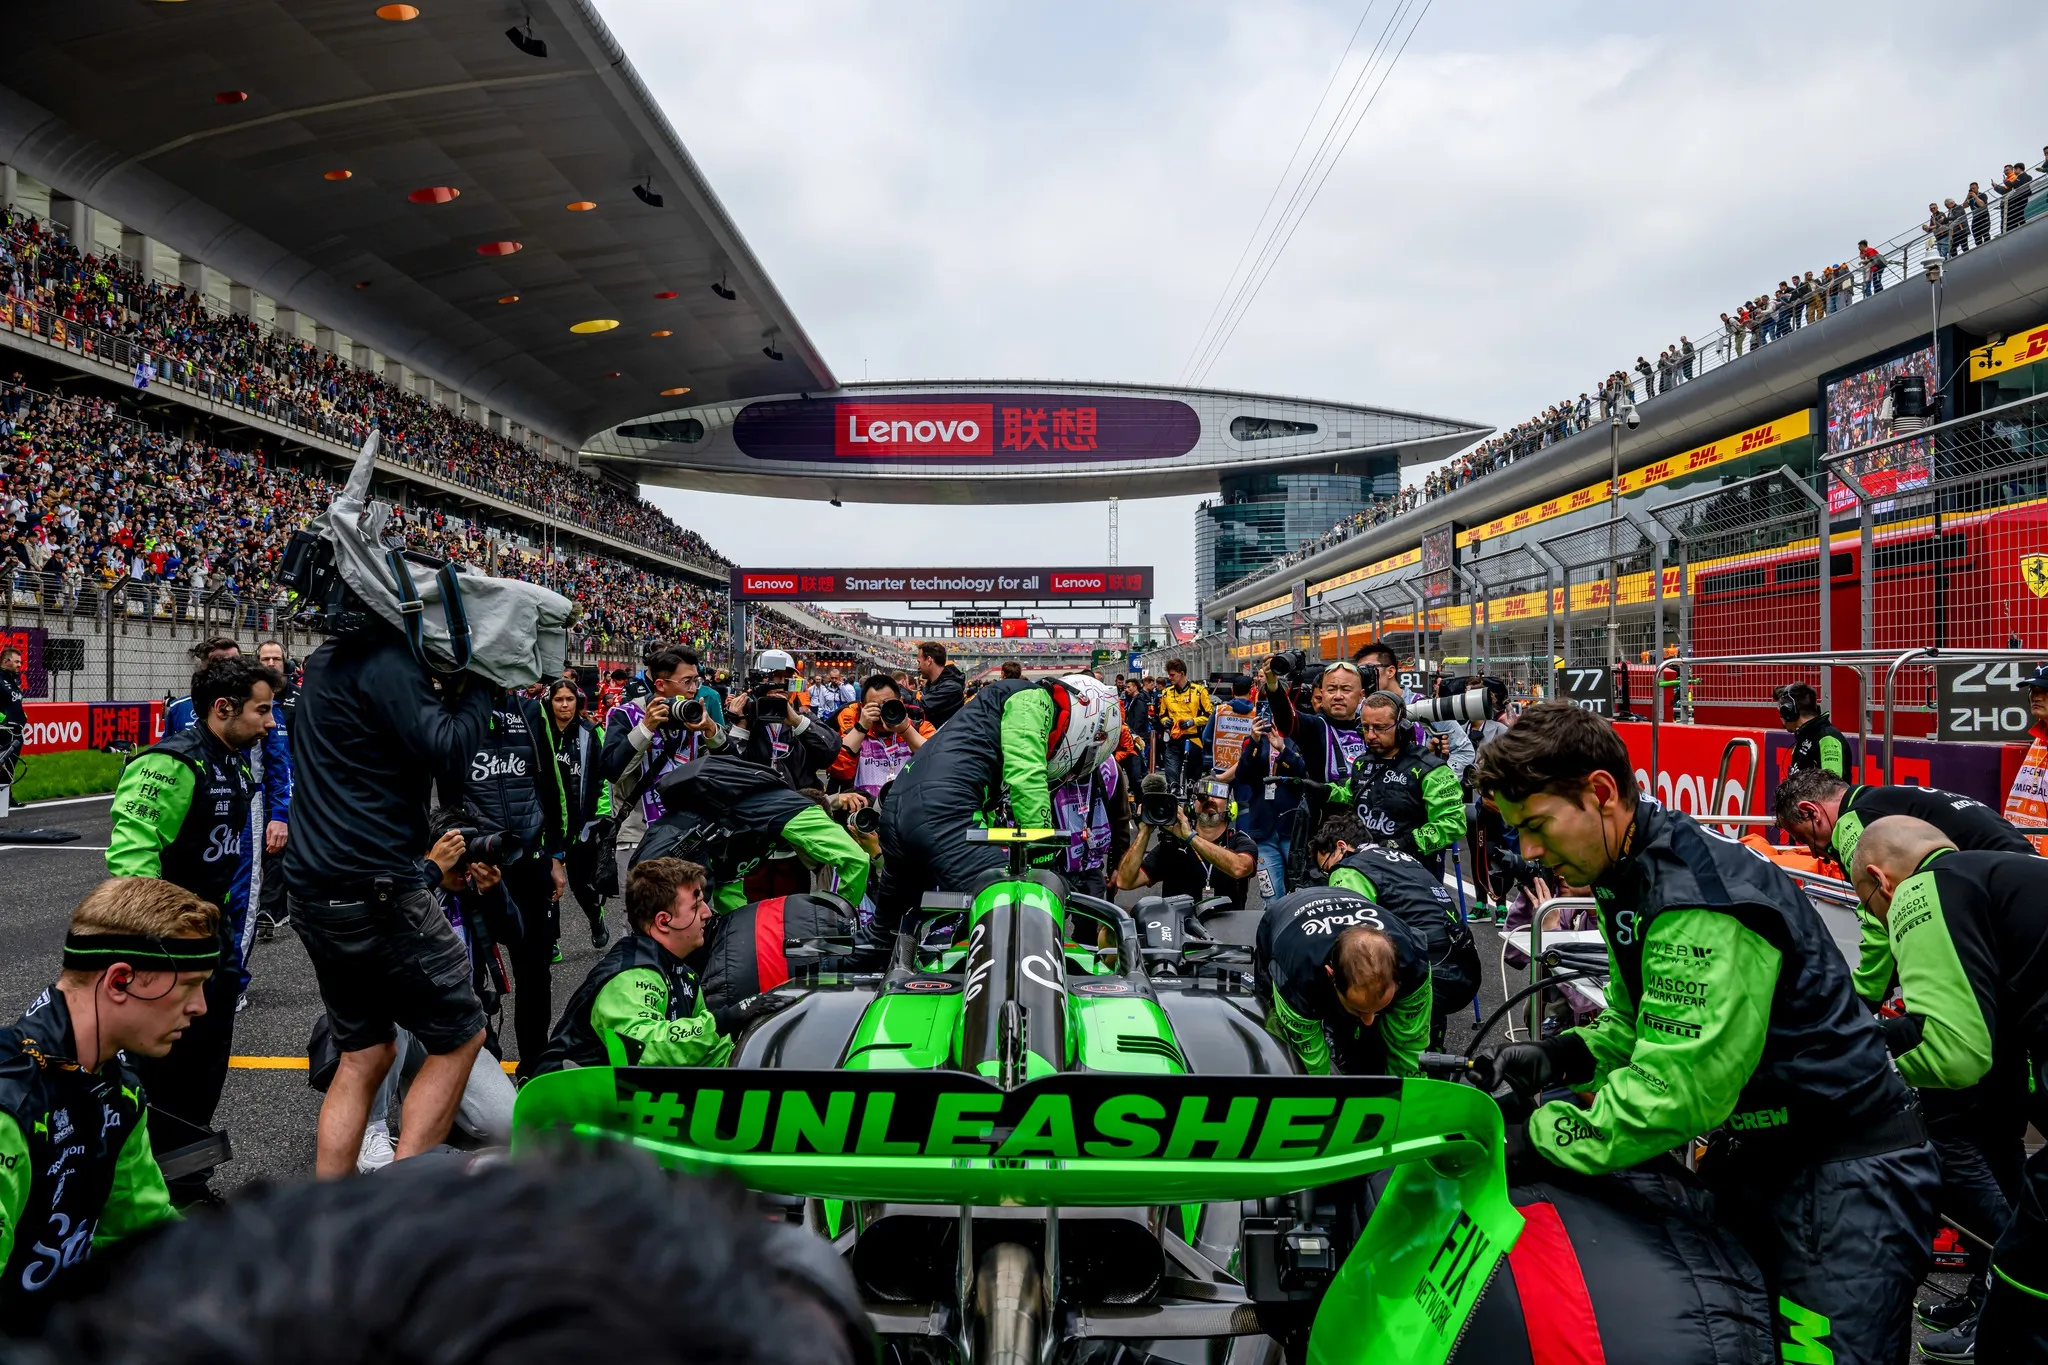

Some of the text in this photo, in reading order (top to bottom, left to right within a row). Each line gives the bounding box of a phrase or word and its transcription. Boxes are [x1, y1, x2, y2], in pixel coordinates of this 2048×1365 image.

[850, 415, 980, 443] Lenovo
[1002, 407, 1098, 452] 联想
[1741, 426, 1775, 452] DHL
[1689, 445, 1718, 468] DHL
[1645, 462, 1669, 483] DHL
[1571, 490, 1591, 508] DHL
[747, 577, 794, 589] Lenovo
[801, 576, 835, 592] 联想
[845, 576, 1039, 592] Smarter technology for all
[1055, 577, 1101, 588] Lenovo
[1108, 574, 1142, 591] 联想
[1400, 673, 1424, 688] 81
[1566, 669, 1603, 692] 77
[1952, 662, 2025, 692] 24
[505, 713, 523, 724] Stak
[1950, 707, 2028, 731] ZHO
[22, 721, 83, 745] enovo
[140, 768, 177, 786] Hyland
[471, 752, 526, 782] Stake
[1383, 770, 1407, 785] Stake
[140, 784, 161, 798] FIX
[1357, 803, 1396, 836] Stake
[203, 824, 240, 863] Sta
[1307, 903, 1342, 916] TEAM
[1893, 895, 1926, 926] MASCOT
[1301, 908, 1385, 936] Stake
[1895, 911, 1932, 943] PIRELLI
[635, 981, 667, 998] Hyland
[1649, 974, 1708, 996] MASCOT
[1647, 987, 1707, 1007] WORKWEAR
[669, 1025, 703, 1043] Stake
[1643, 1012, 1702, 1039] PIRELLI
[618, 1088, 1402, 1160] #UNLEASHED
[1730, 1107, 1788, 1130] CREW
[1428, 1208, 1490, 1308] FIX
[1413, 1274, 1452, 1336] NETWORK
